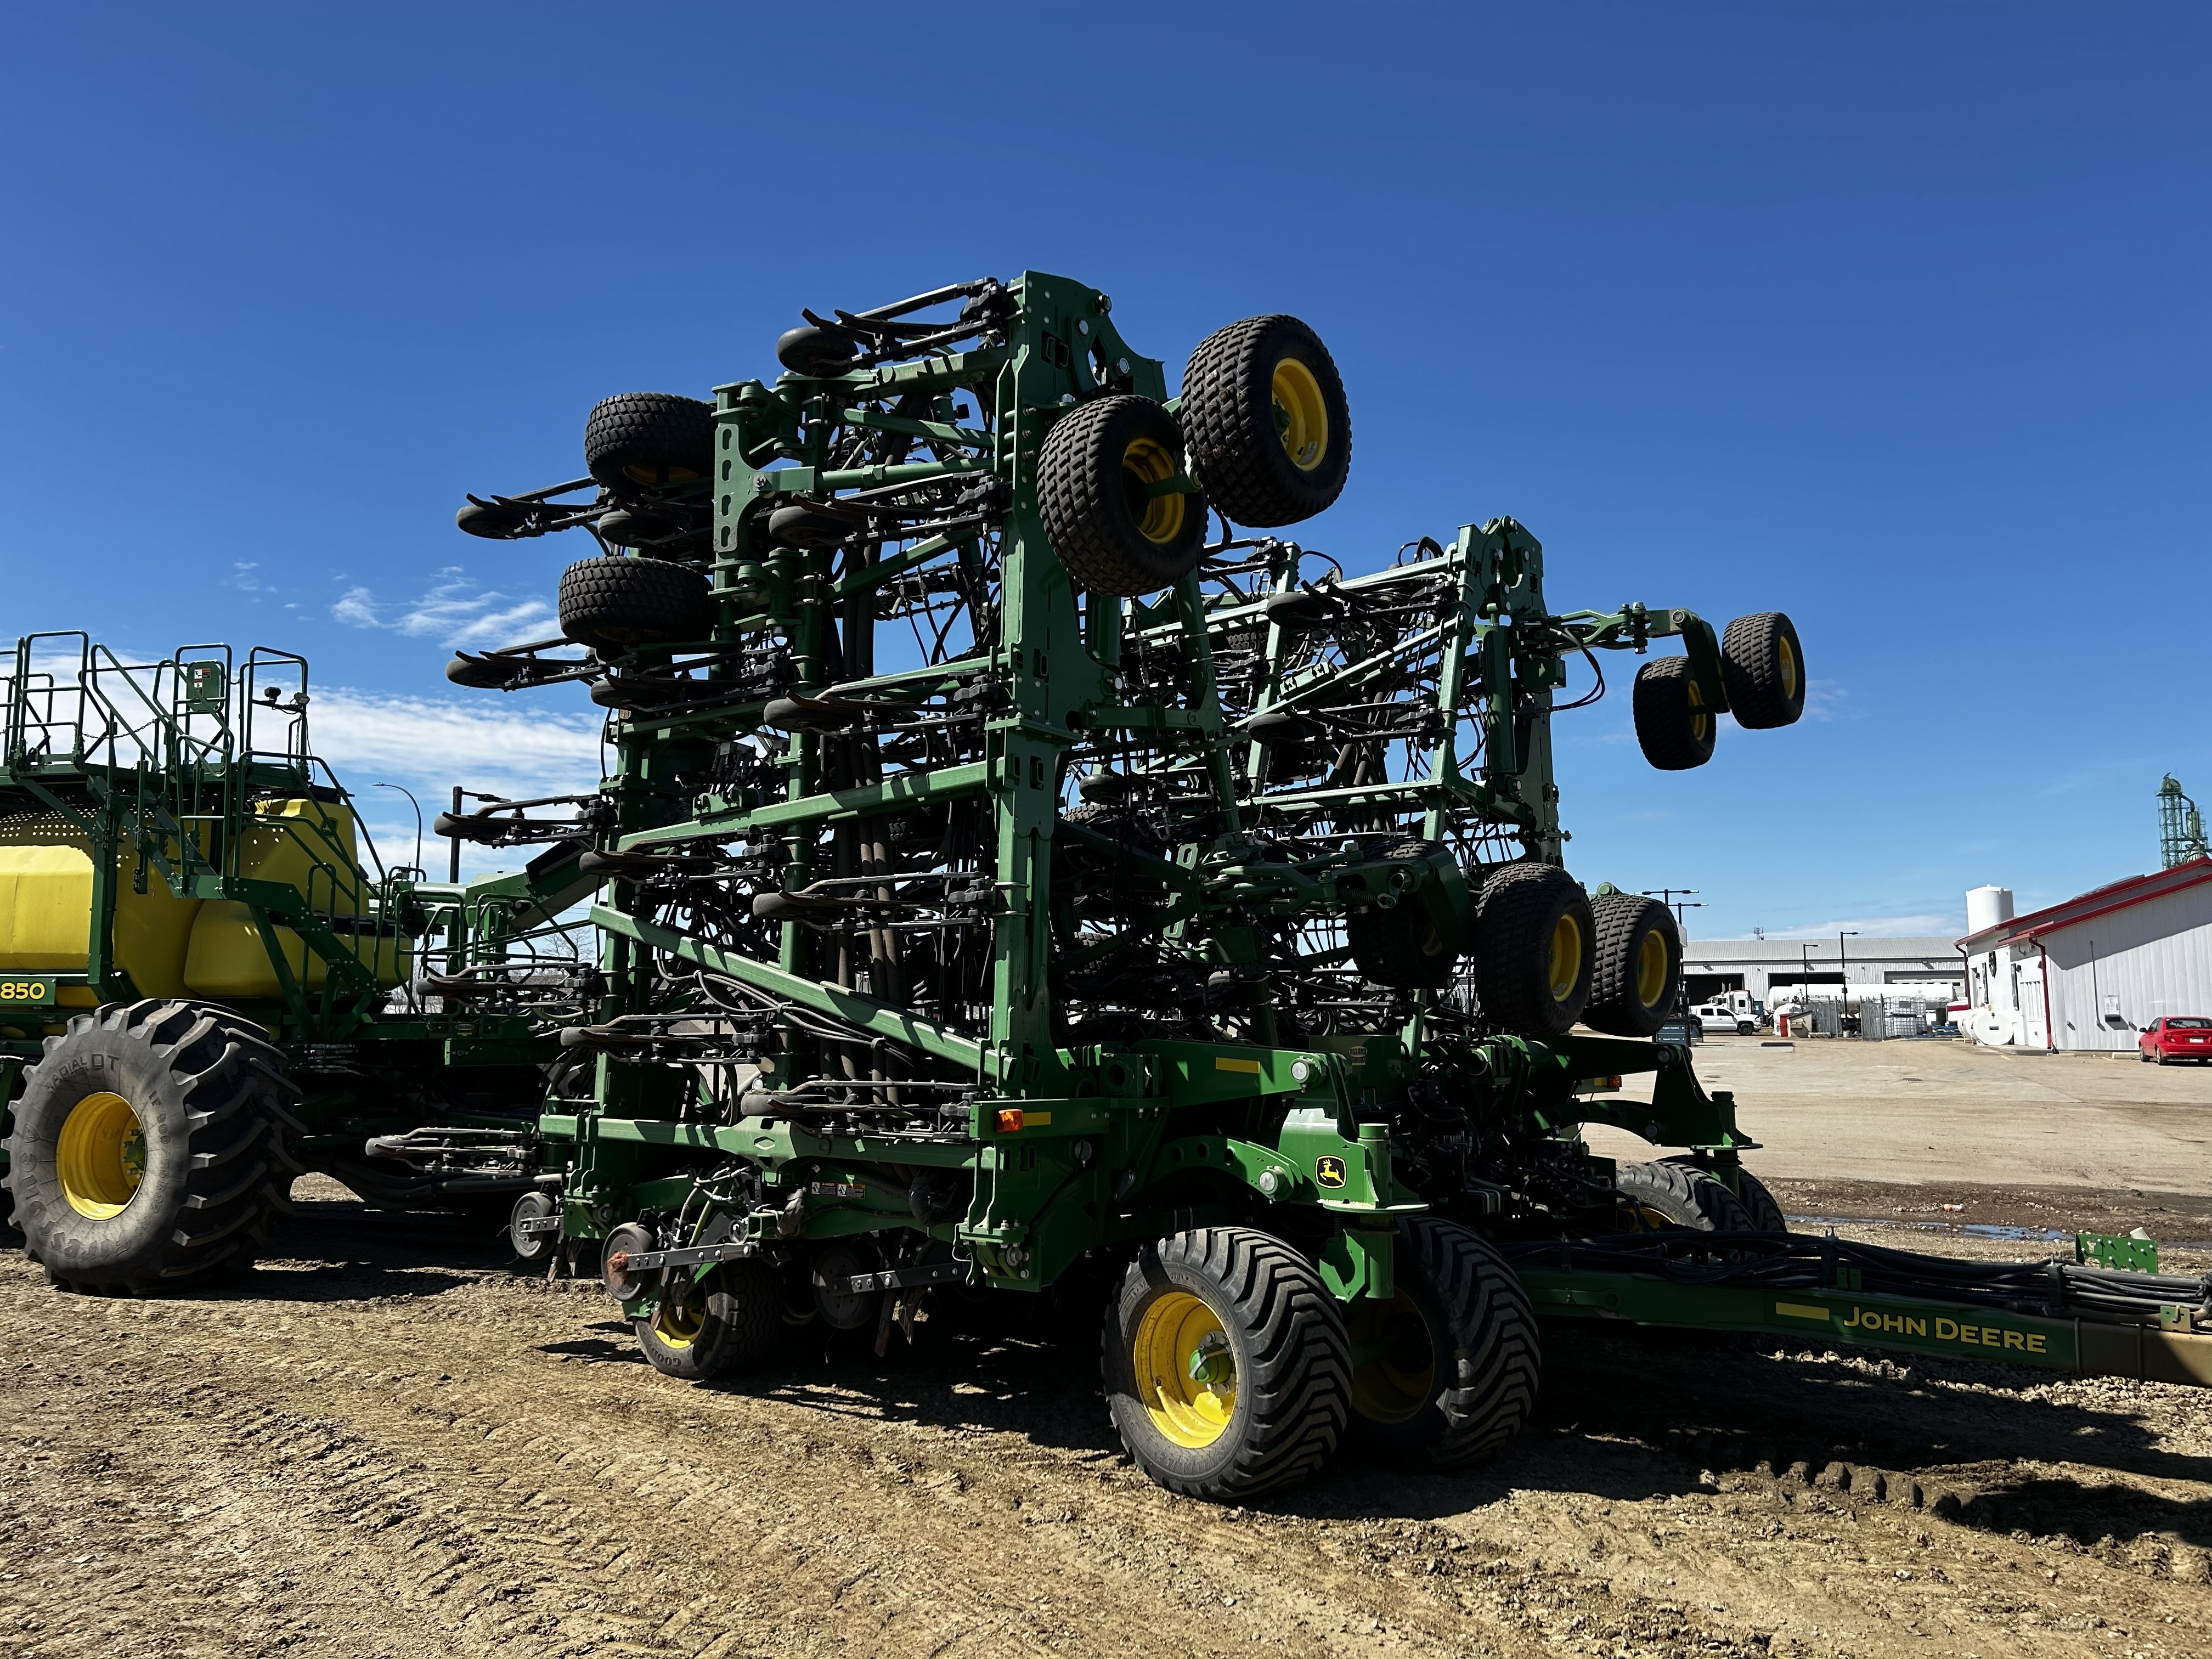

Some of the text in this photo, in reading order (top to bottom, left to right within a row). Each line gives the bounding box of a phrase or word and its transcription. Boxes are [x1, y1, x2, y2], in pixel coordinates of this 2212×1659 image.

[1, 982, 46, 1000] 850
[1844, 1306, 2047, 1353] JOHN DEERE
